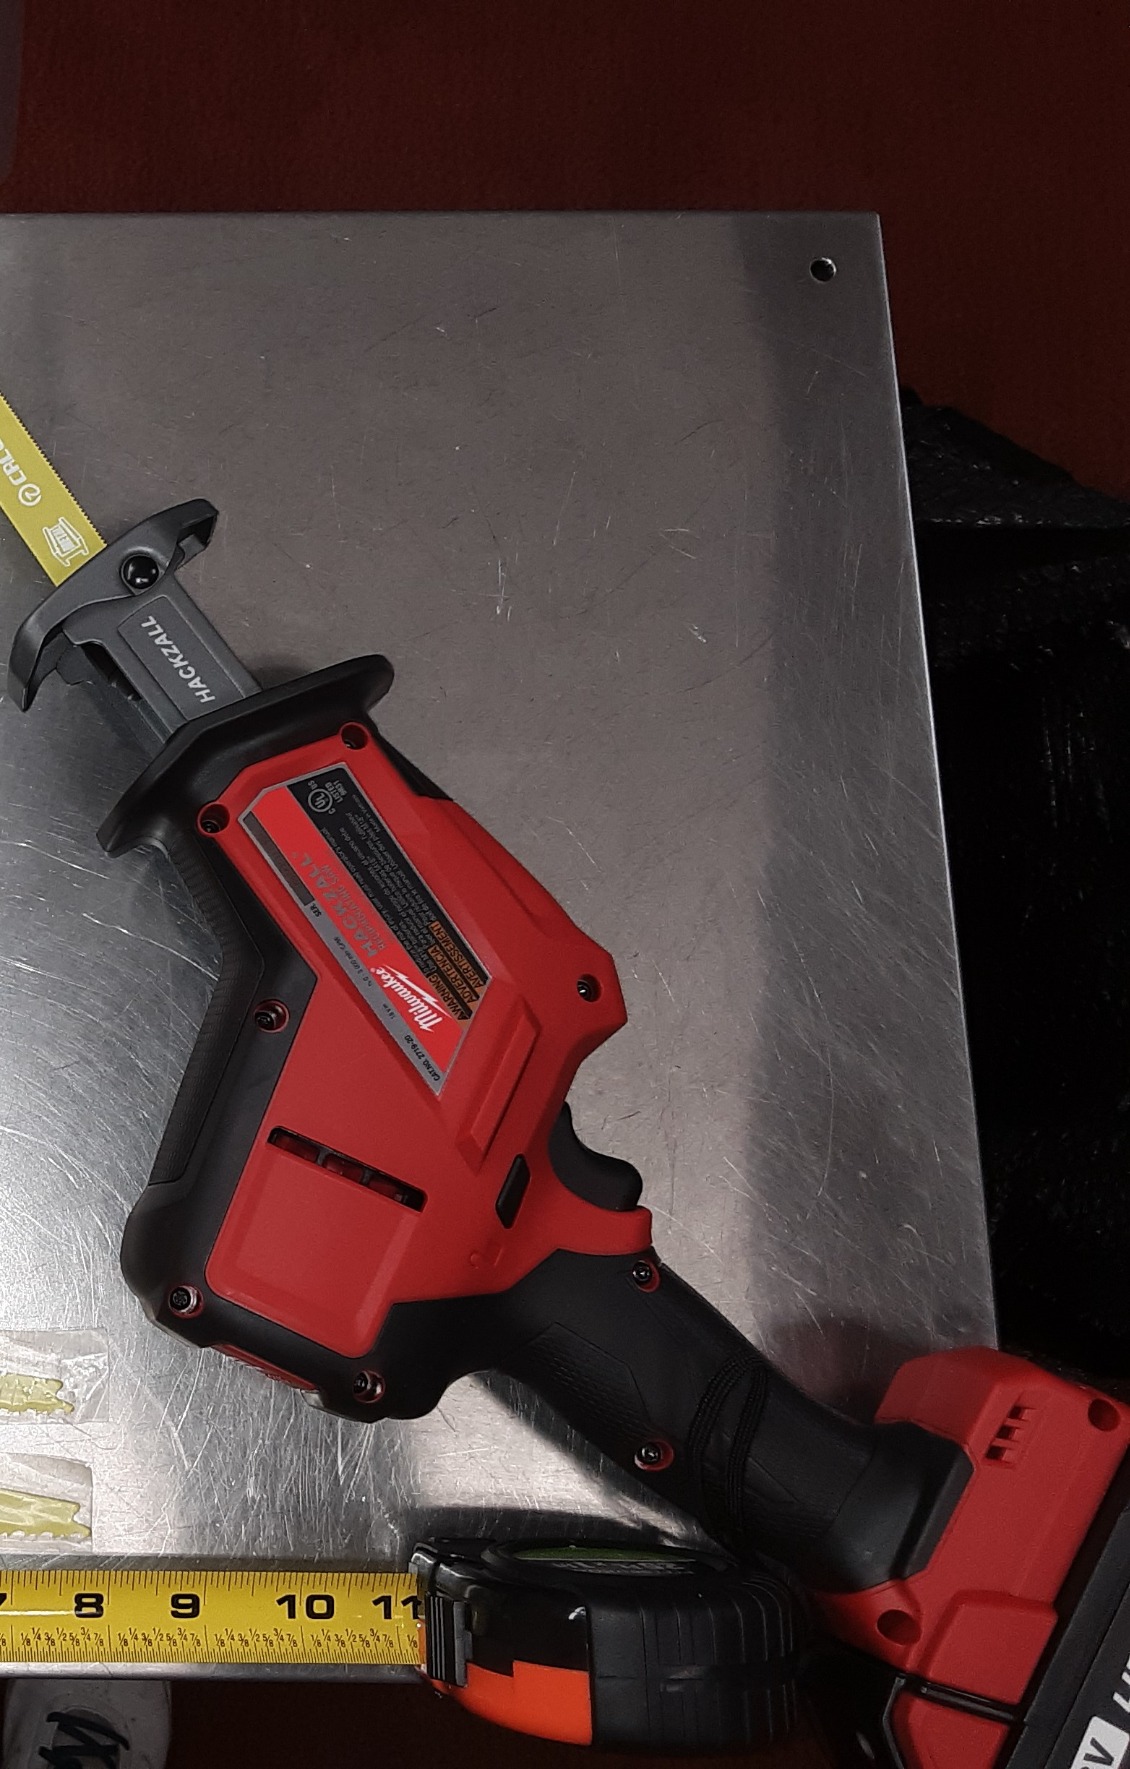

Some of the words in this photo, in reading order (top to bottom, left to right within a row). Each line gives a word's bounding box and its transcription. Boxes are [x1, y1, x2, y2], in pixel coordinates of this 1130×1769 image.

[0, 440, 27, 486] CAL
[141, 615, 216, 703] HACKZALL
[322, 779, 344, 804] LISTED
[296, 851, 378, 958] HACKZALL
[428, 945, 477, 1006] ADVERTENCIA
[429, 921, 484, 991] AVERTISSEMENT
[374, 966, 443, 1032] Milwaukee
[426, 972, 463, 1016] WARNING
[402, 1032, 426, 1061] 2719-20
[74, 1593, 104, 1618] 8
[170, 1593, 200, 1619] 9
[276, 1594, 335, 1620] 10
[372, 1595, 421, 1620] 11
